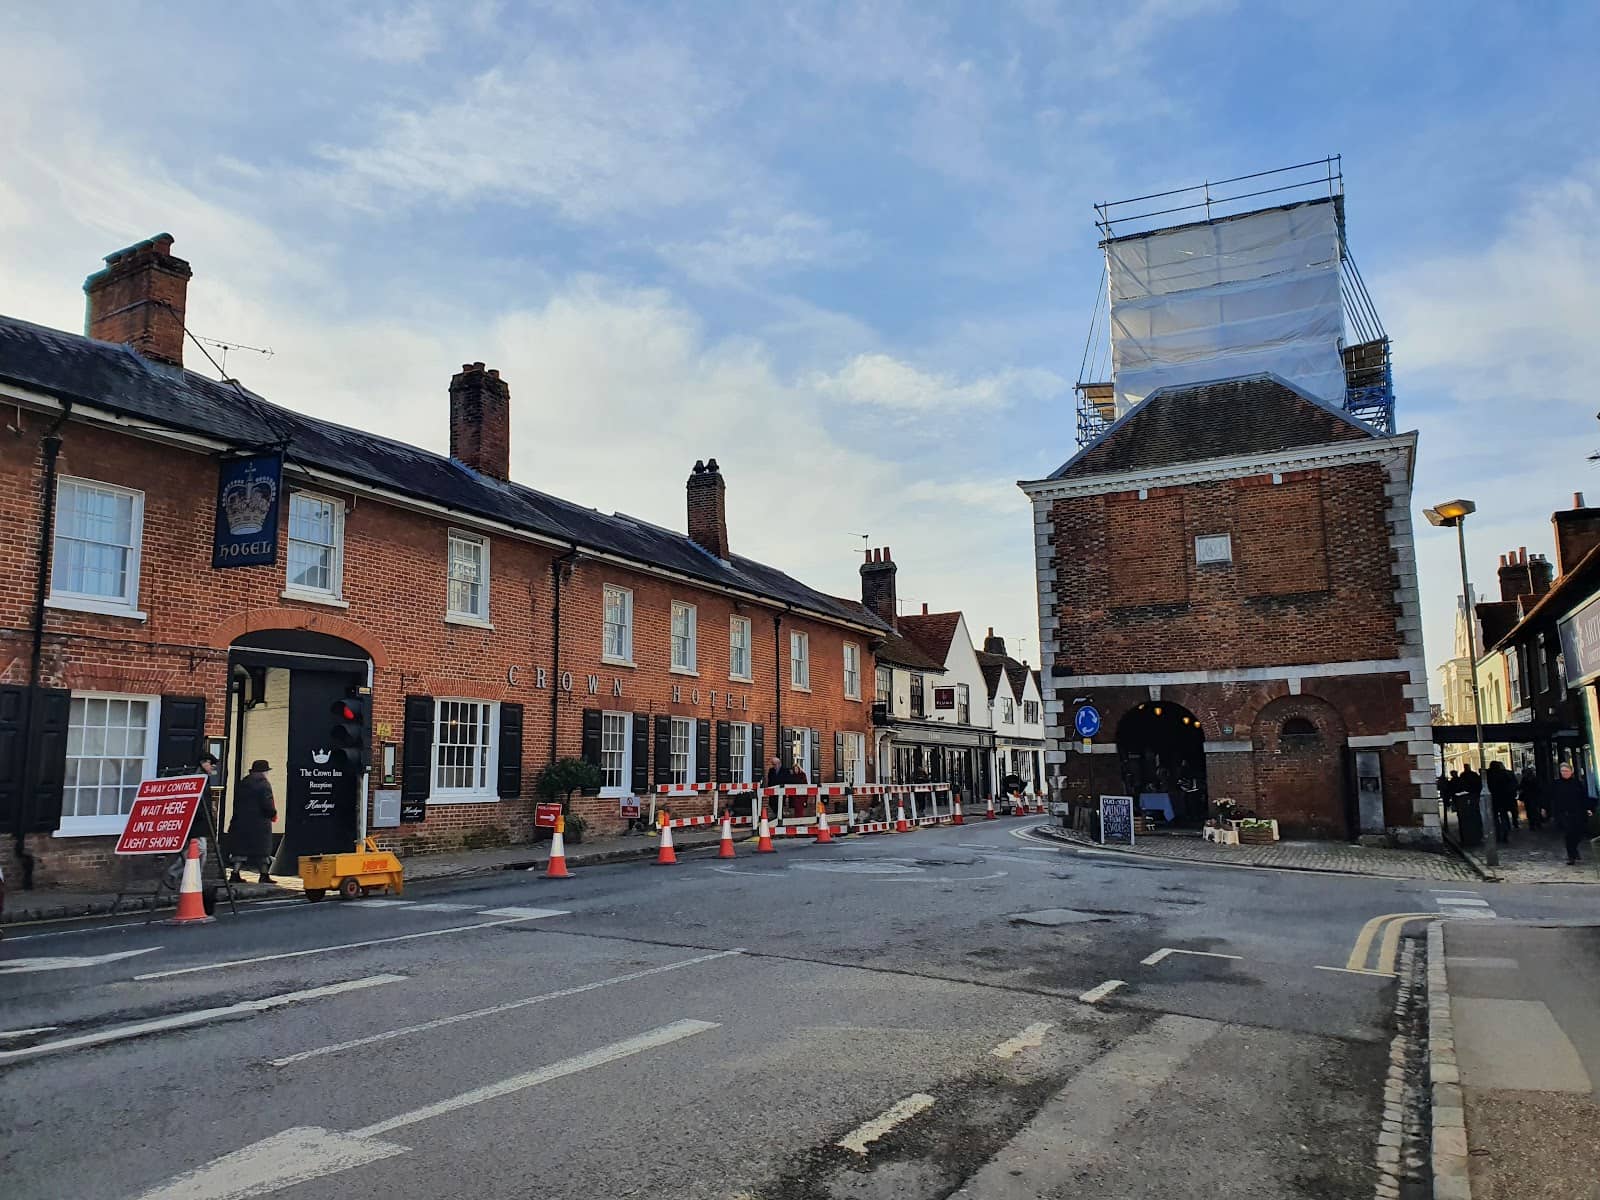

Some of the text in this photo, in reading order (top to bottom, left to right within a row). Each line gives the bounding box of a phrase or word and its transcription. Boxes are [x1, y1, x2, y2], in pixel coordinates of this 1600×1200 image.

[508, 664, 748, 711] CROWN HOTEL
[300, 768, 342, 777] The Crown Inn
[143, 782, 197, 793] 3-WAY CONTROL
[141, 801, 188, 816] WAIT HERE
[133, 819, 183, 832] UNTIL GREEN
[123, 836, 179, 849] LIGHT SHOWS
